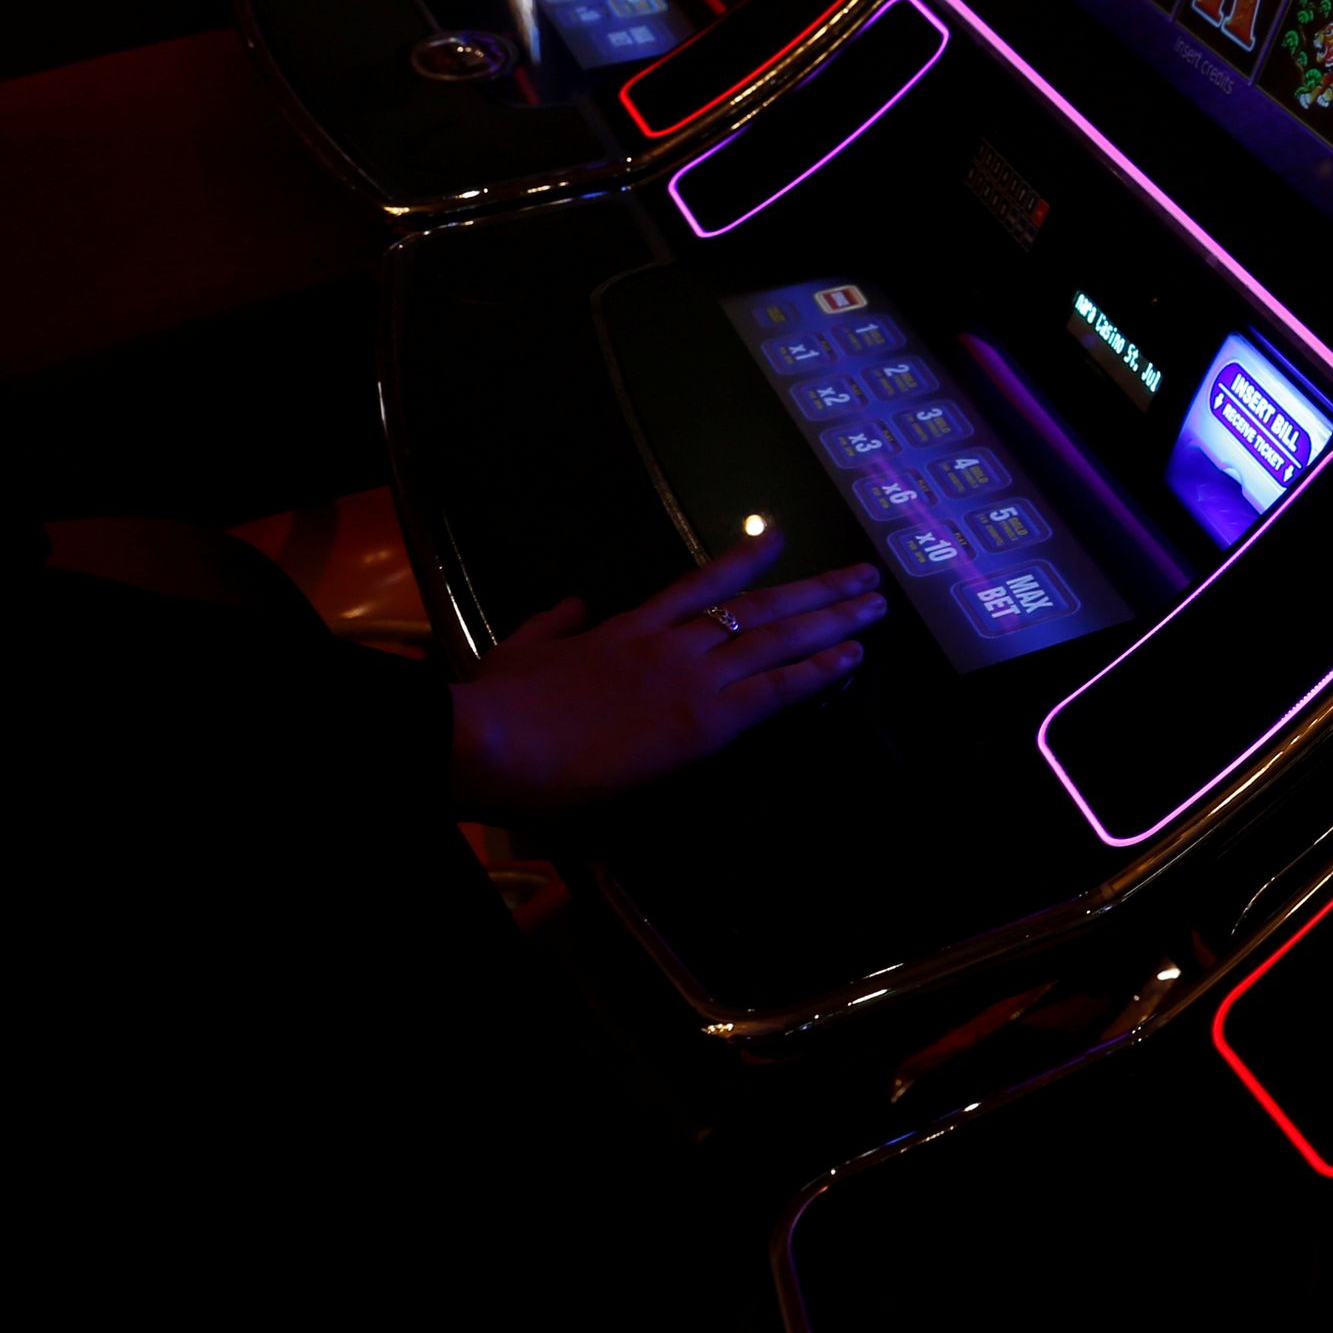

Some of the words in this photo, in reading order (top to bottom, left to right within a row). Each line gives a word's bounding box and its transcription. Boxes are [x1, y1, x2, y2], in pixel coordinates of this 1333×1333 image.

[1095, 312, 1126, 354] Casino
[789, 344, 820, 361] x1
[817, 386, 850, 406] x2
[1231, 373, 1277, 424] INSERT
[1270, 413, 1300, 452] BILL
[848, 432, 882, 453] x3
[1222, 403, 1258, 443] RECEIVE
[1253, 434, 1285, 471] TICKET
[882, 482, 918, 504] x6
[989, 506, 1019, 523] 5
[915, 531, 959, 563] x10
[976, 585, 1022, 619] BET
[1005, 574, 1054, 615] MAX
